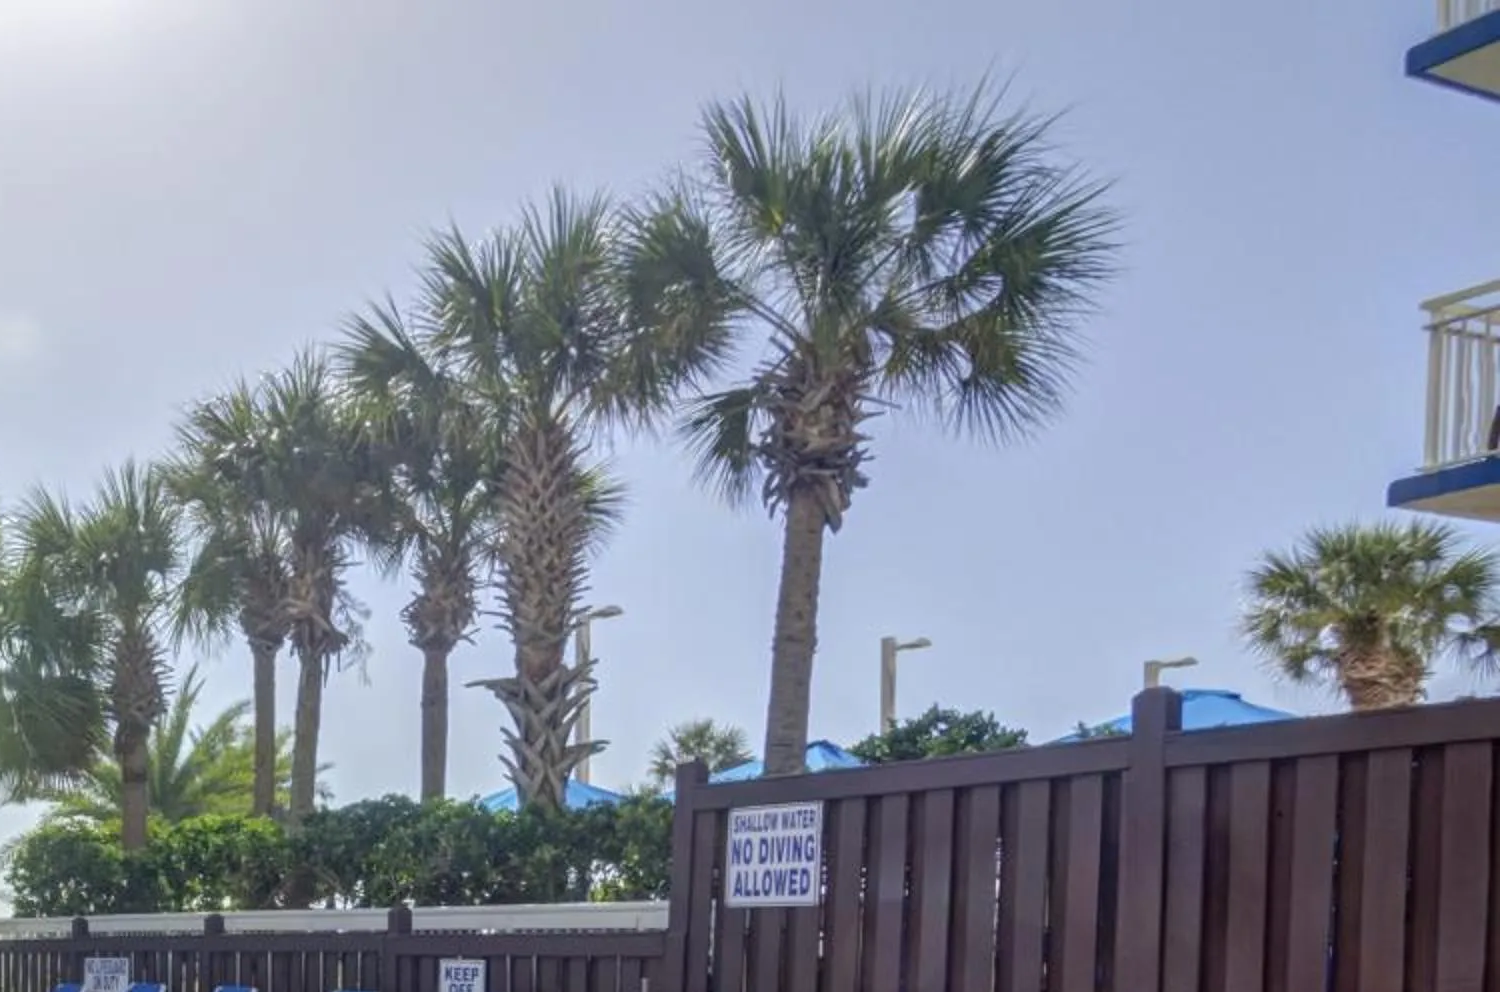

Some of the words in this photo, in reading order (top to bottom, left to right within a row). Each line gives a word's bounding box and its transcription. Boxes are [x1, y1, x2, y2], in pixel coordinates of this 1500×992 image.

[734, 812, 779, 833] SHALLOW
[781, 808, 816, 830] WATER
[732, 839, 752, 864] NO
[758, 834, 814, 865] DIVING
[733, 867, 810, 896] ALLOWED
[444, 966, 479, 981] KEEP
